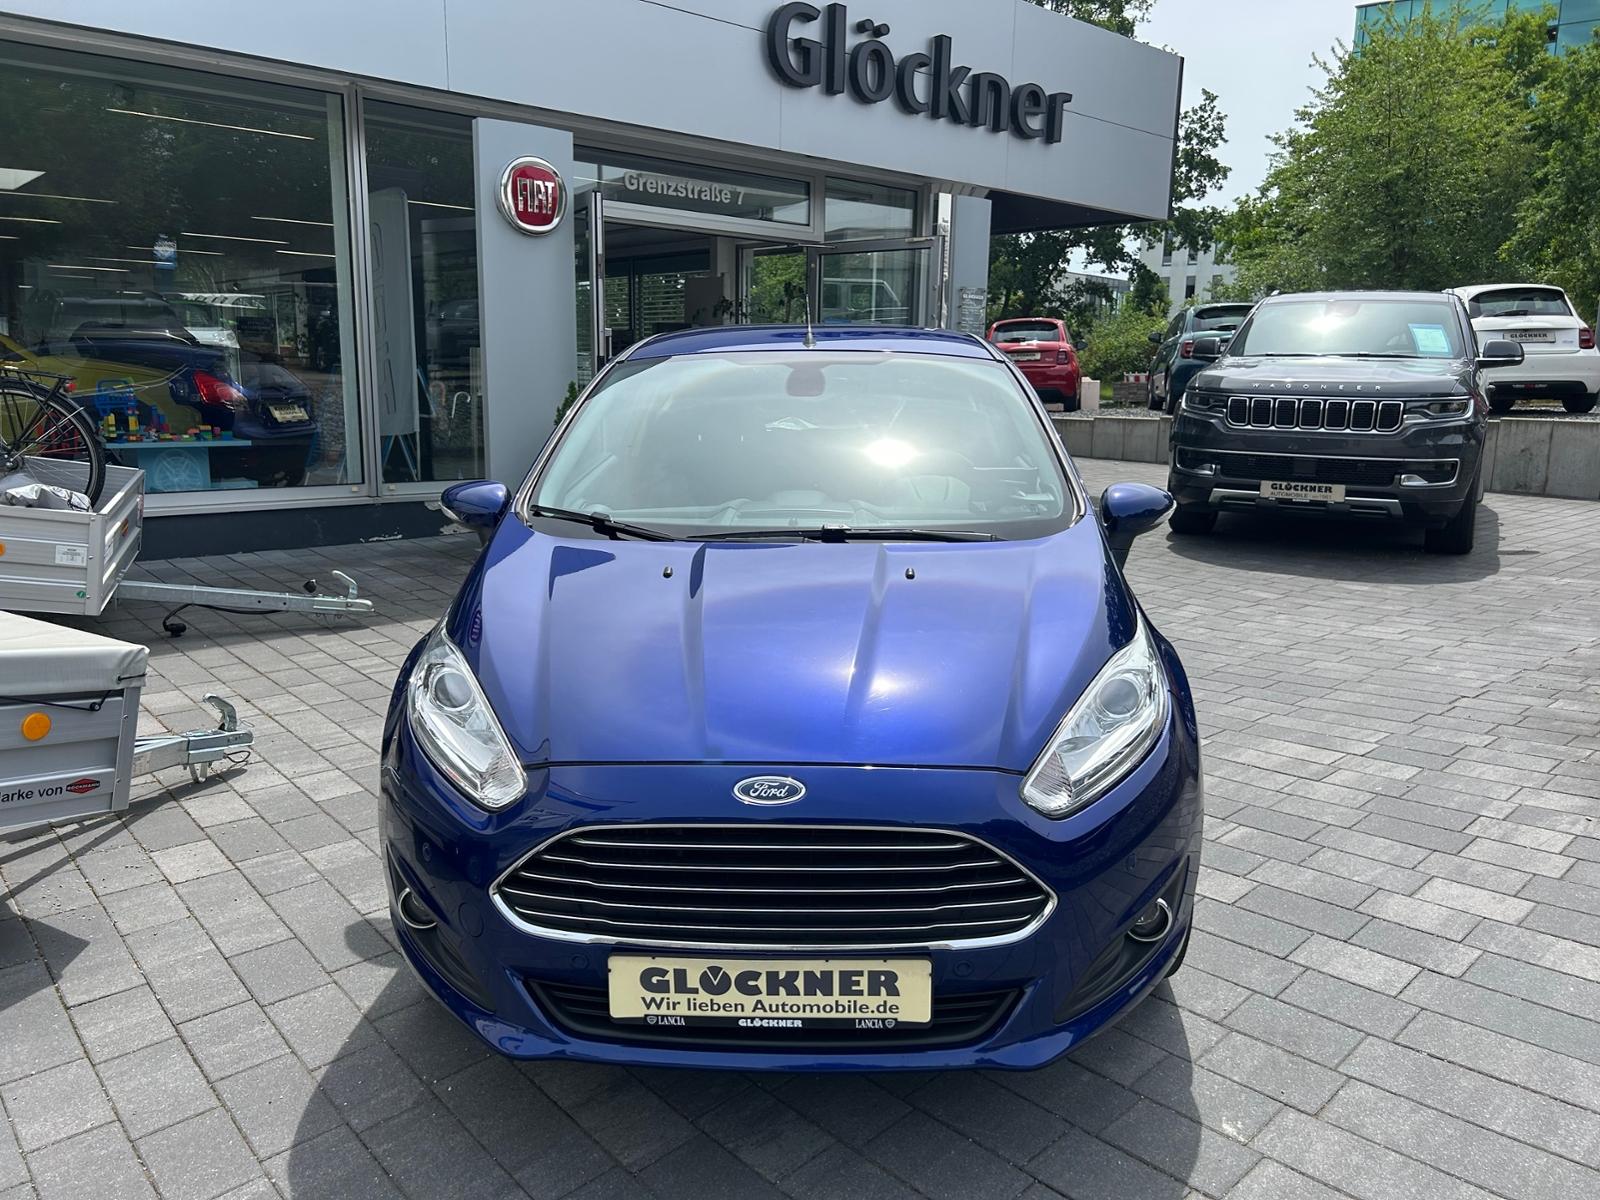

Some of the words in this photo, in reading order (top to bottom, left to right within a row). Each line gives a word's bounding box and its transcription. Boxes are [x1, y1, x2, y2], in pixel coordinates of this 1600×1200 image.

[767, 2, 1073, 143] Glöckner
[517, 177, 555, 214] FIAT
[624, 171, 731, 203] Grenzstraße
[736, 188, 745, 205] 7
[1253, 383, 1381, 391] WAGONEER
[0, 788, 34, 803] arke
[38, 786, 63, 798] von
[749, 781, 790, 797] Ford
[641, 996, 681, 1011] Wir
[687, 997, 745, 1013] lieben
[751, 999, 900, 1014] Automobile.de
[658, 1016, 686, 1026] LANCIA
[855, 1019, 883, 1029] LANCIA
